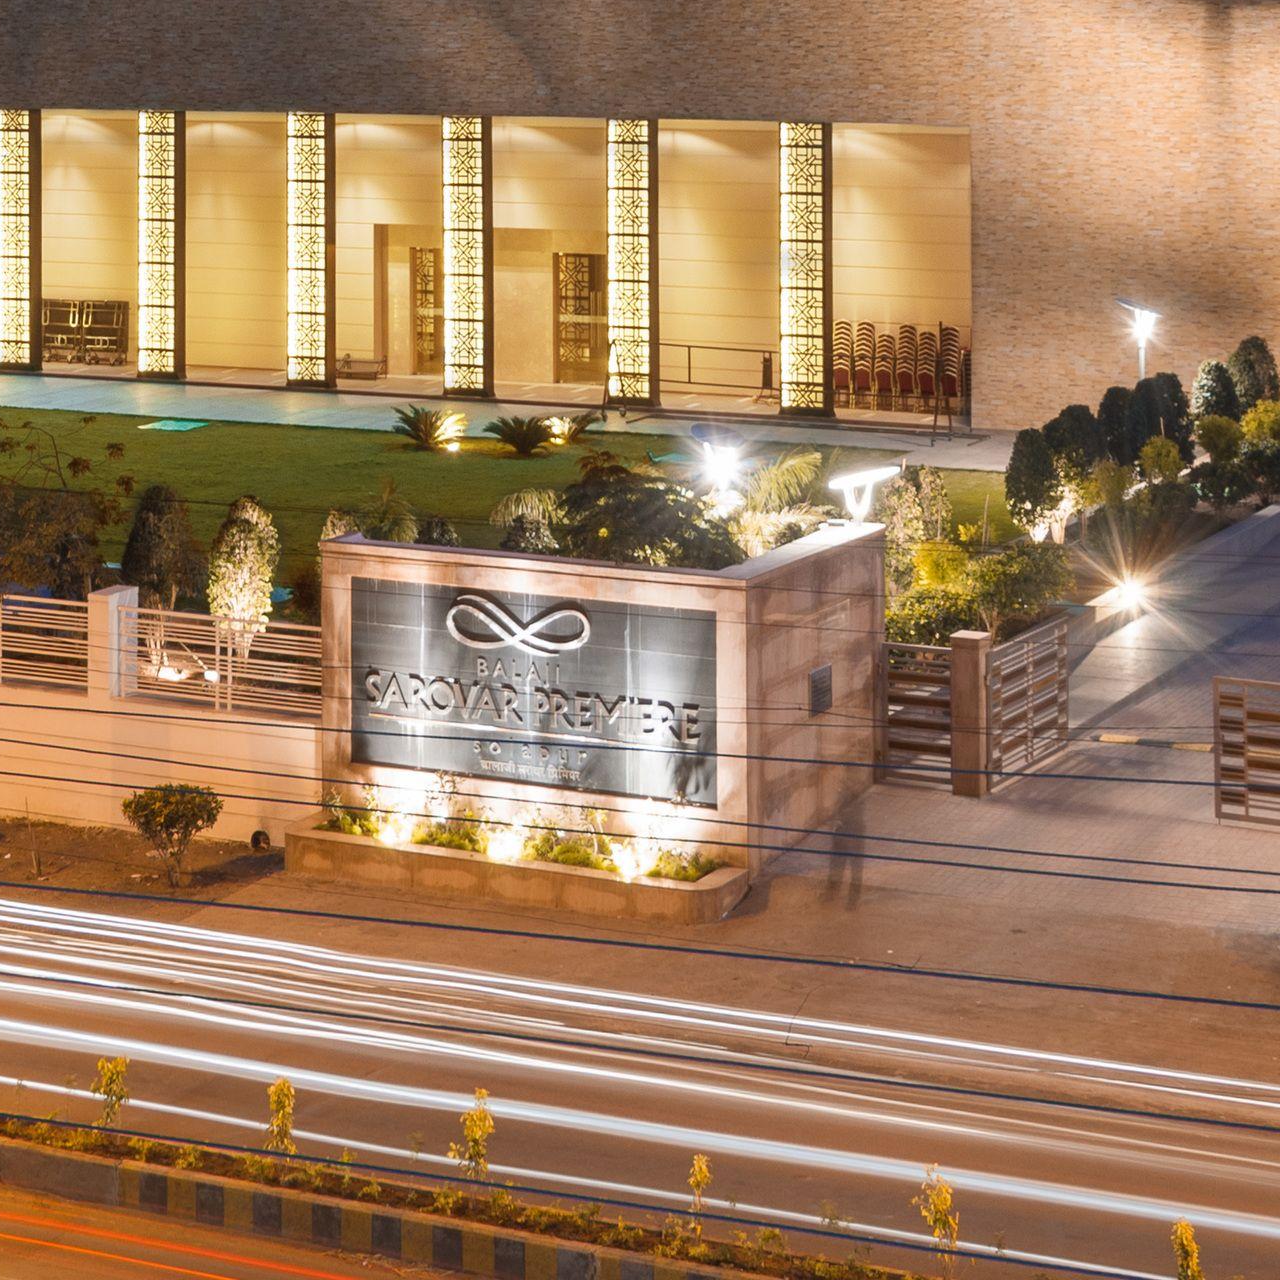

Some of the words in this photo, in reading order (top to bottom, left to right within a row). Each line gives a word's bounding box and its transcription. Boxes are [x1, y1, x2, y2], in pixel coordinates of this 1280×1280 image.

[477, 655, 561, 689] BALAJI
[365, 670, 524, 724] SAROVAR
[533, 685, 702, 745] PREMIERE
[473, 736, 588, 765] soapur
